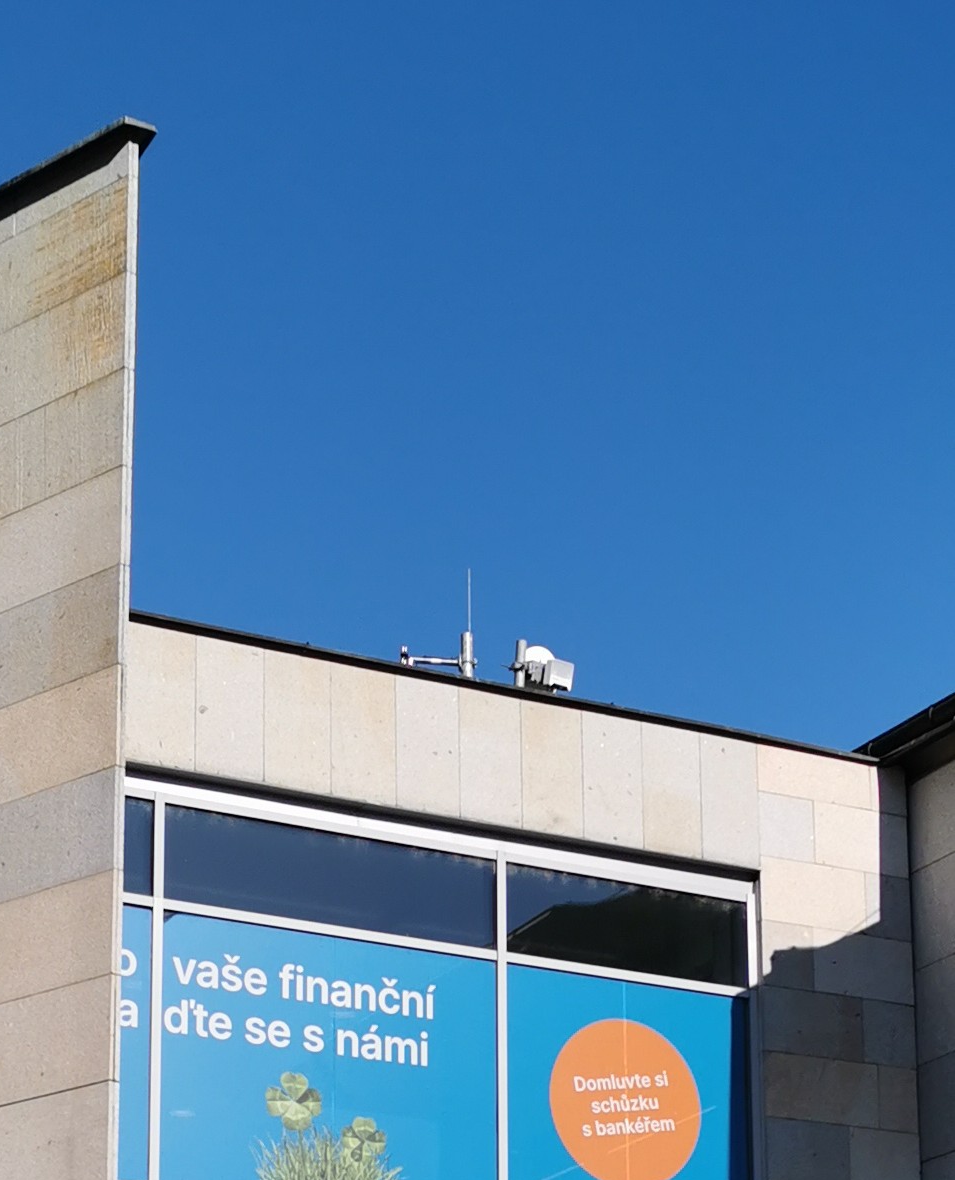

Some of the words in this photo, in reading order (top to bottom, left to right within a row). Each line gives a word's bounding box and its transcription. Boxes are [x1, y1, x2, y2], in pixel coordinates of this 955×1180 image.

[172, 954, 268, 995] vaše
[279, 963, 436, 1020] finanční
[245, 1017, 291, 1048] se
[303, 1024, 325, 1052] s
[336, 1025, 429, 1066] námi
[573, 1074, 651, 1092] Domluvte
[654, 1070, 669, 1087] si
[591, 1094, 659, 1114] schůzku
[582, 1123, 593, 1137] s
[595, 1116, 675, 1136] bankéřem
